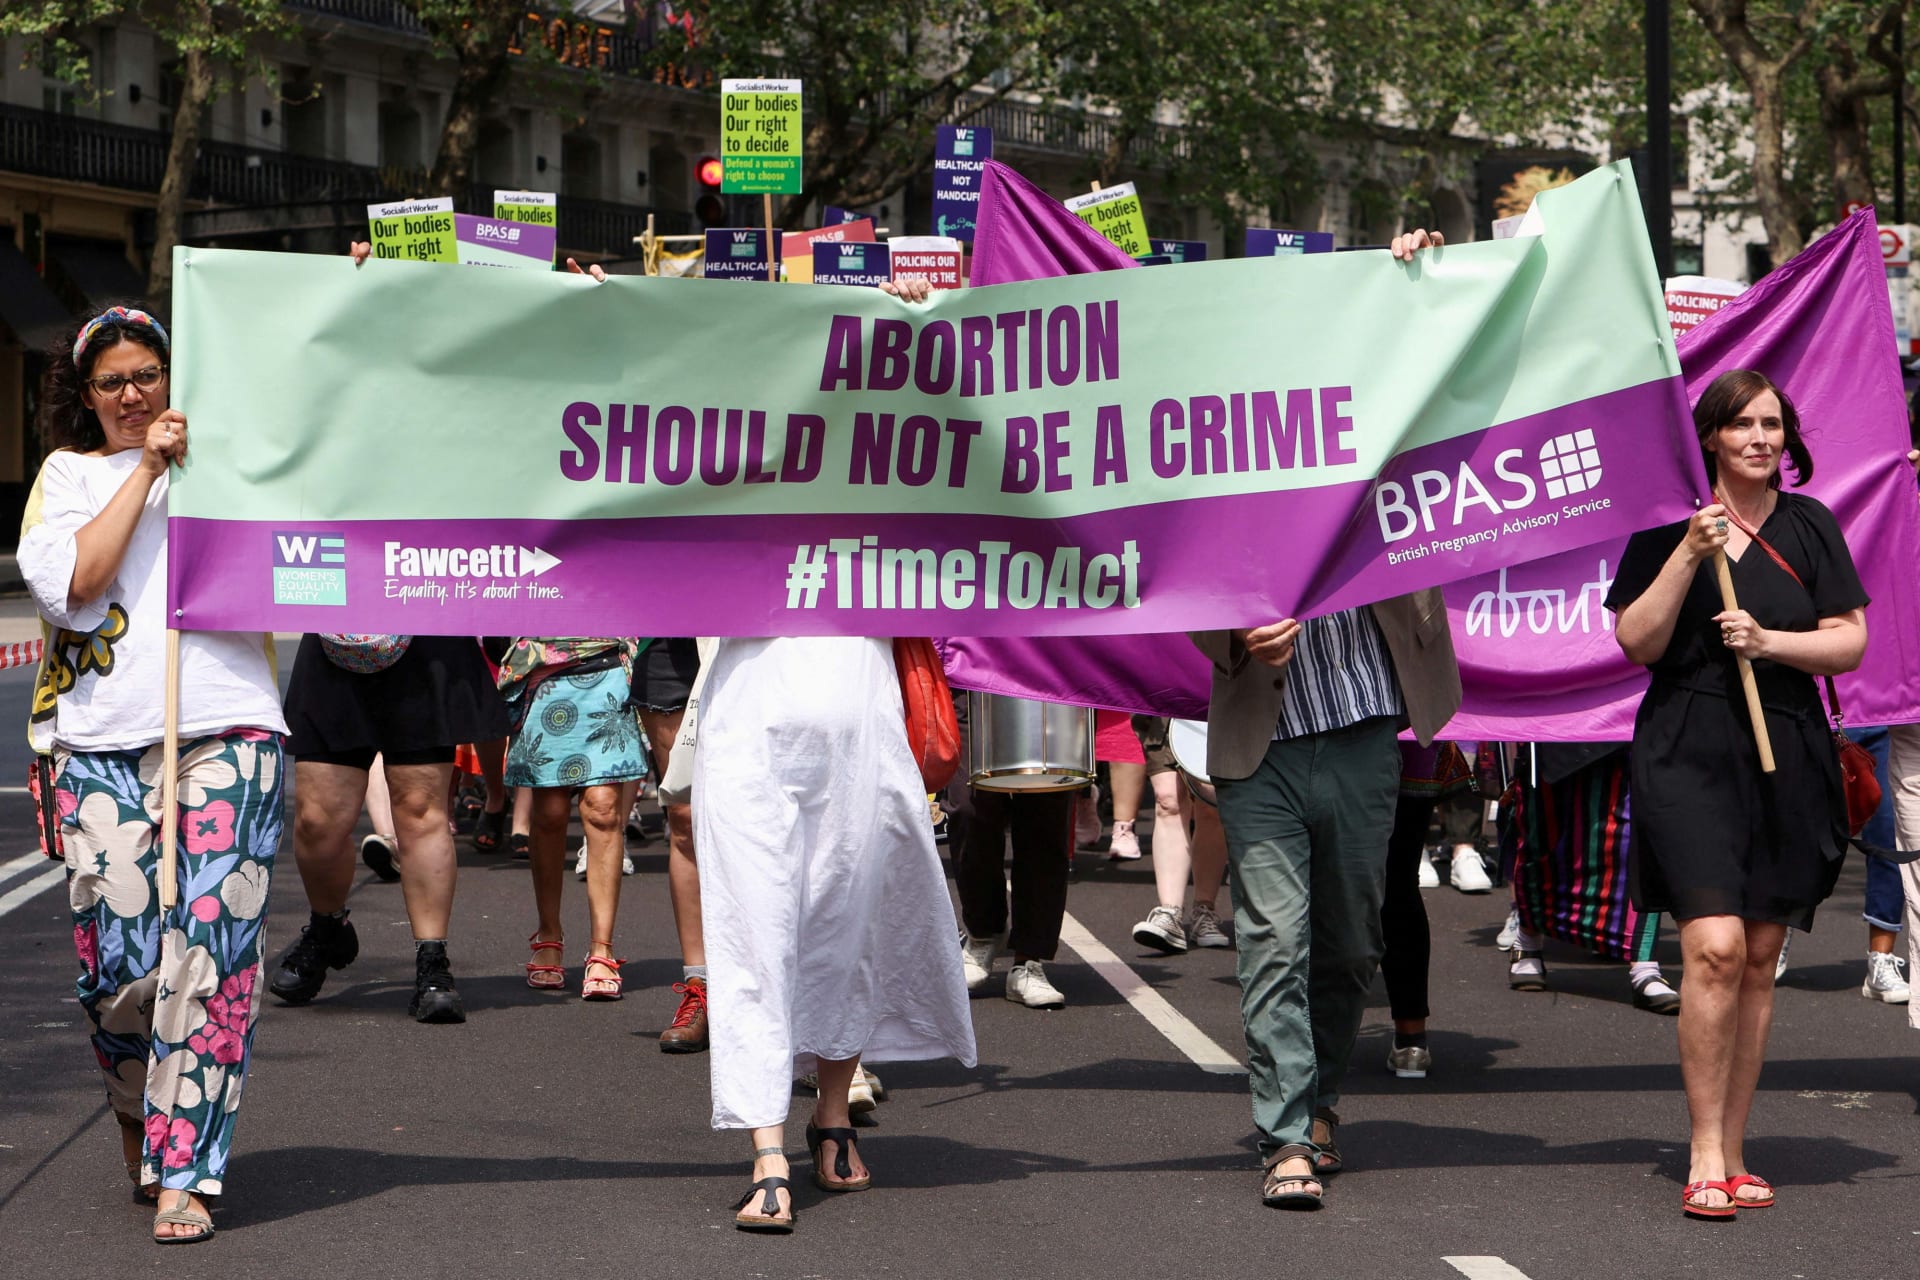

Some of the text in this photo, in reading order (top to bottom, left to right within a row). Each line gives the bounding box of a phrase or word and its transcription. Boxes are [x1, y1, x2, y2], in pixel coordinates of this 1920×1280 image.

[726, 94, 798, 112] Our bodies
[726, 114, 787, 136] Our right
[726, 134, 789, 152] to decide
[726, 158, 753, 168] Defend
[755, 160, 760, 168] a
[935, 159, 984, 171] HEALTHCAR
[725, 170, 785, 183] right to choose
[952, 175, 971, 186] NOT
[381, 203, 439, 217] Socialist Worker
[497, 205, 552, 224] Our bodies
[1075, 200, 1137, 225] ur bodies
[374, 214, 451, 238] Our bodies
[475, 223, 507, 240] BPAS
[377, 238, 442, 260] Our right
[895, 255, 955, 267] POLICING OUR
[814, 274, 888, 285] HEALTHCARE
[930, 271, 938, 283] IS
[940, 271, 957, 283] THE
[1668, 294, 1718, 311] POLICING
[819, 299, 1119, 398] ABORTION
[559, 386, 1357, 494] SHOULD NOT BE A CRIME
[1375, 447, 1537, 544] BPAS
[1387, 497, 1612, 566] British Pregnancy Advisory Service
[384, 541, 517, 577] Fawcett
[278, 570, 337, 582] WOMEN'S
[785, 535, 1142, 610] #TimeToAct
[279, 581, 340, 592] EQUALITY
[384, 578, 564, 606] Equality. It's about time.
[1465, 559, 1614, 638] about
